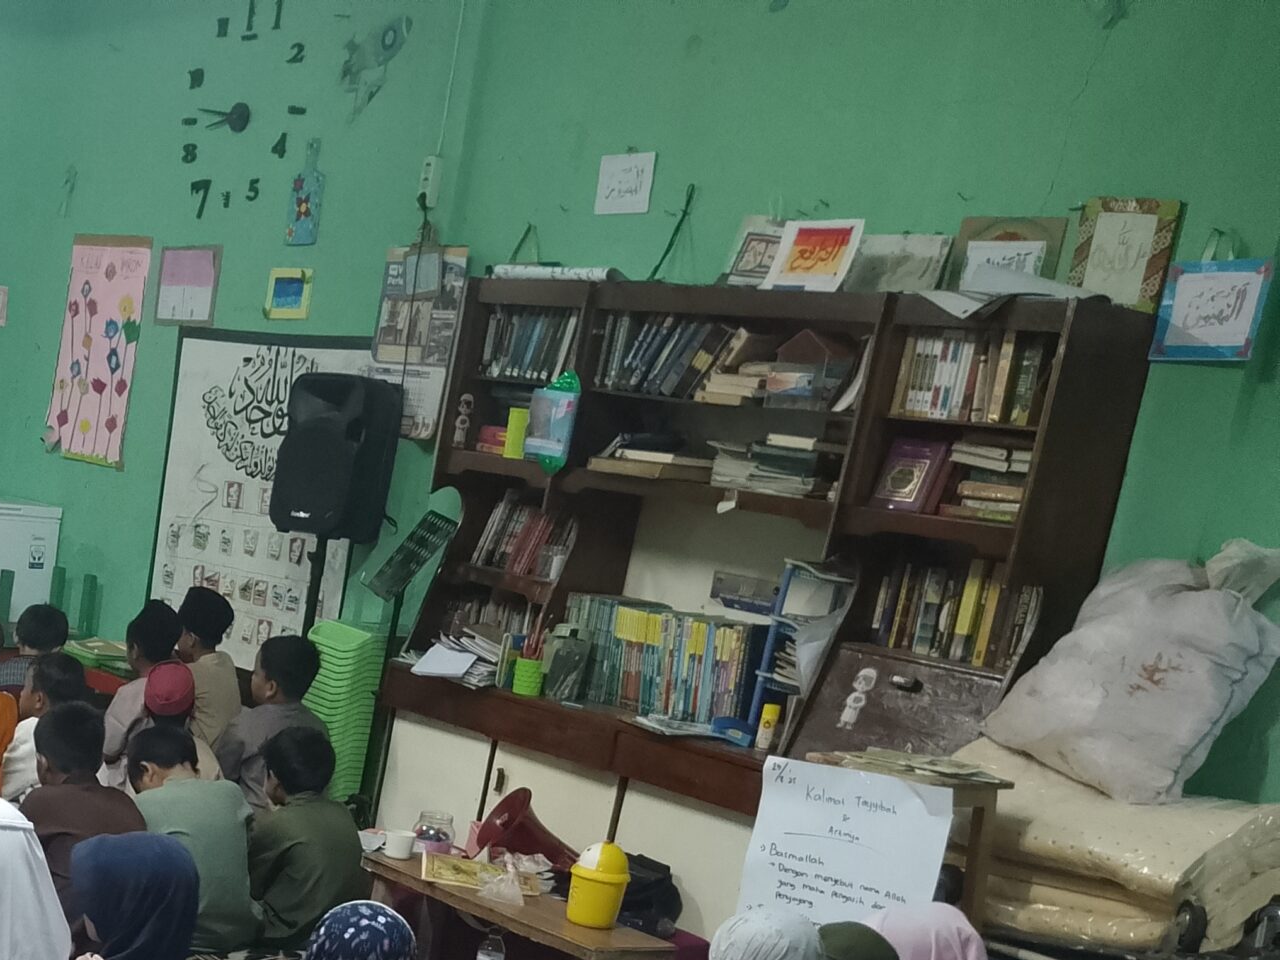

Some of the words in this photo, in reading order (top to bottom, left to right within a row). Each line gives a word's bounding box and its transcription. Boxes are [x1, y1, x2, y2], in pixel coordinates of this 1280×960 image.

[286, 42, 305, 64] 2
[181, 143, 198, 164] 8
[271, 132, 288, 159] 4
[190, 179, 212, 219] 7
[245, 178, 260, 201] 5
[769, 842, 824, 866] Basmallah
[778, 864, 808, 879] Dengan
[884, 890, 906, 904] Allah
